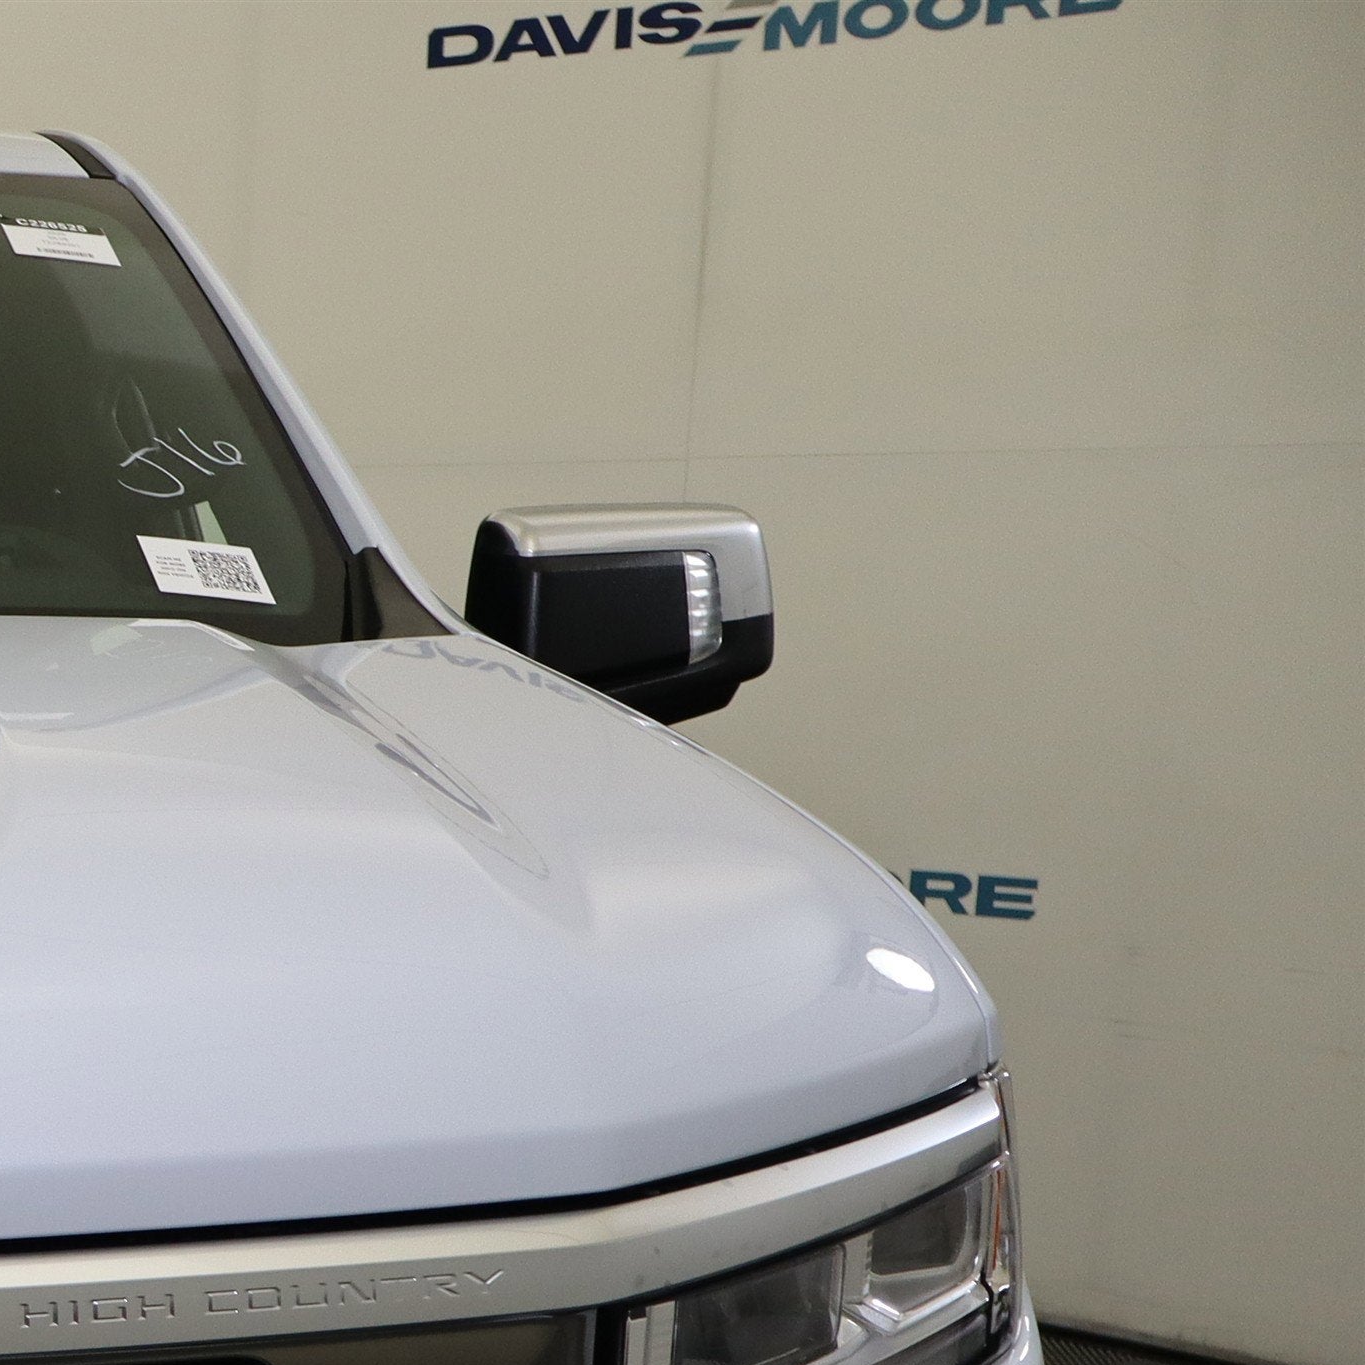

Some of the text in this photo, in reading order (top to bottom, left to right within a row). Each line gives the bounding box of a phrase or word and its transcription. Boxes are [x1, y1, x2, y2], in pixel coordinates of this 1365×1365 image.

[427, 2, 703, 69] DAVIS
[888, 868, 1039, 921] RE
[20, 1269, 504, 1329] HIGH COUNTRY
